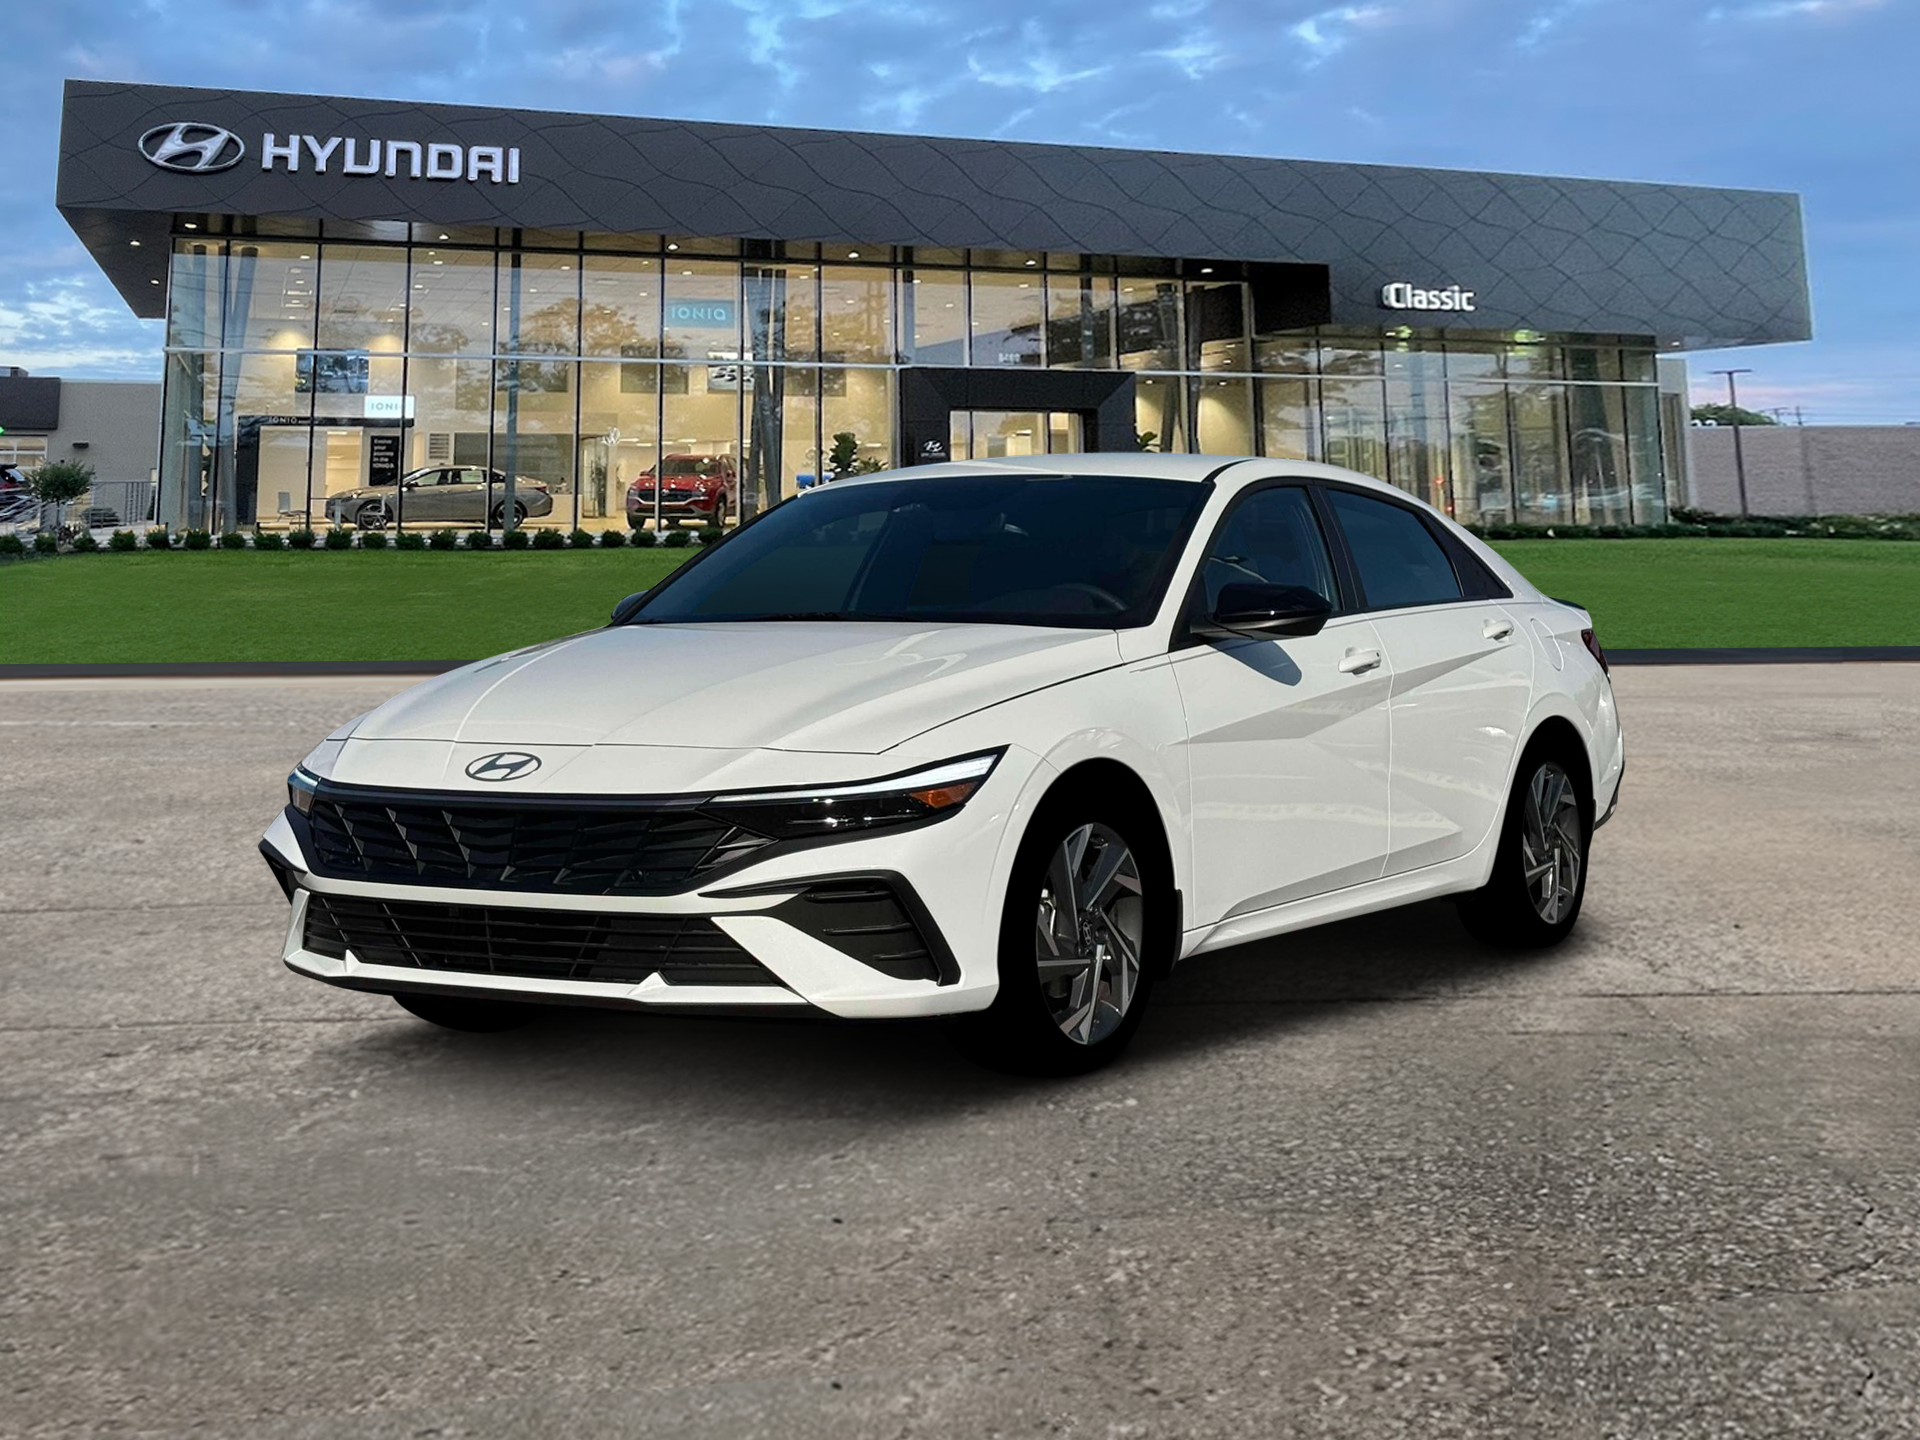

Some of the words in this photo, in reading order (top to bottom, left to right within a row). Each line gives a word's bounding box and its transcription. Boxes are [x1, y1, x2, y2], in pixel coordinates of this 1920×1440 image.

[262, 133, 520, 184] HYUNDAI
[1382, 283, 1476, 312] Classic
[671, 306, 726, 321] IONIQ
[371, 402, 402, 411] IONI
